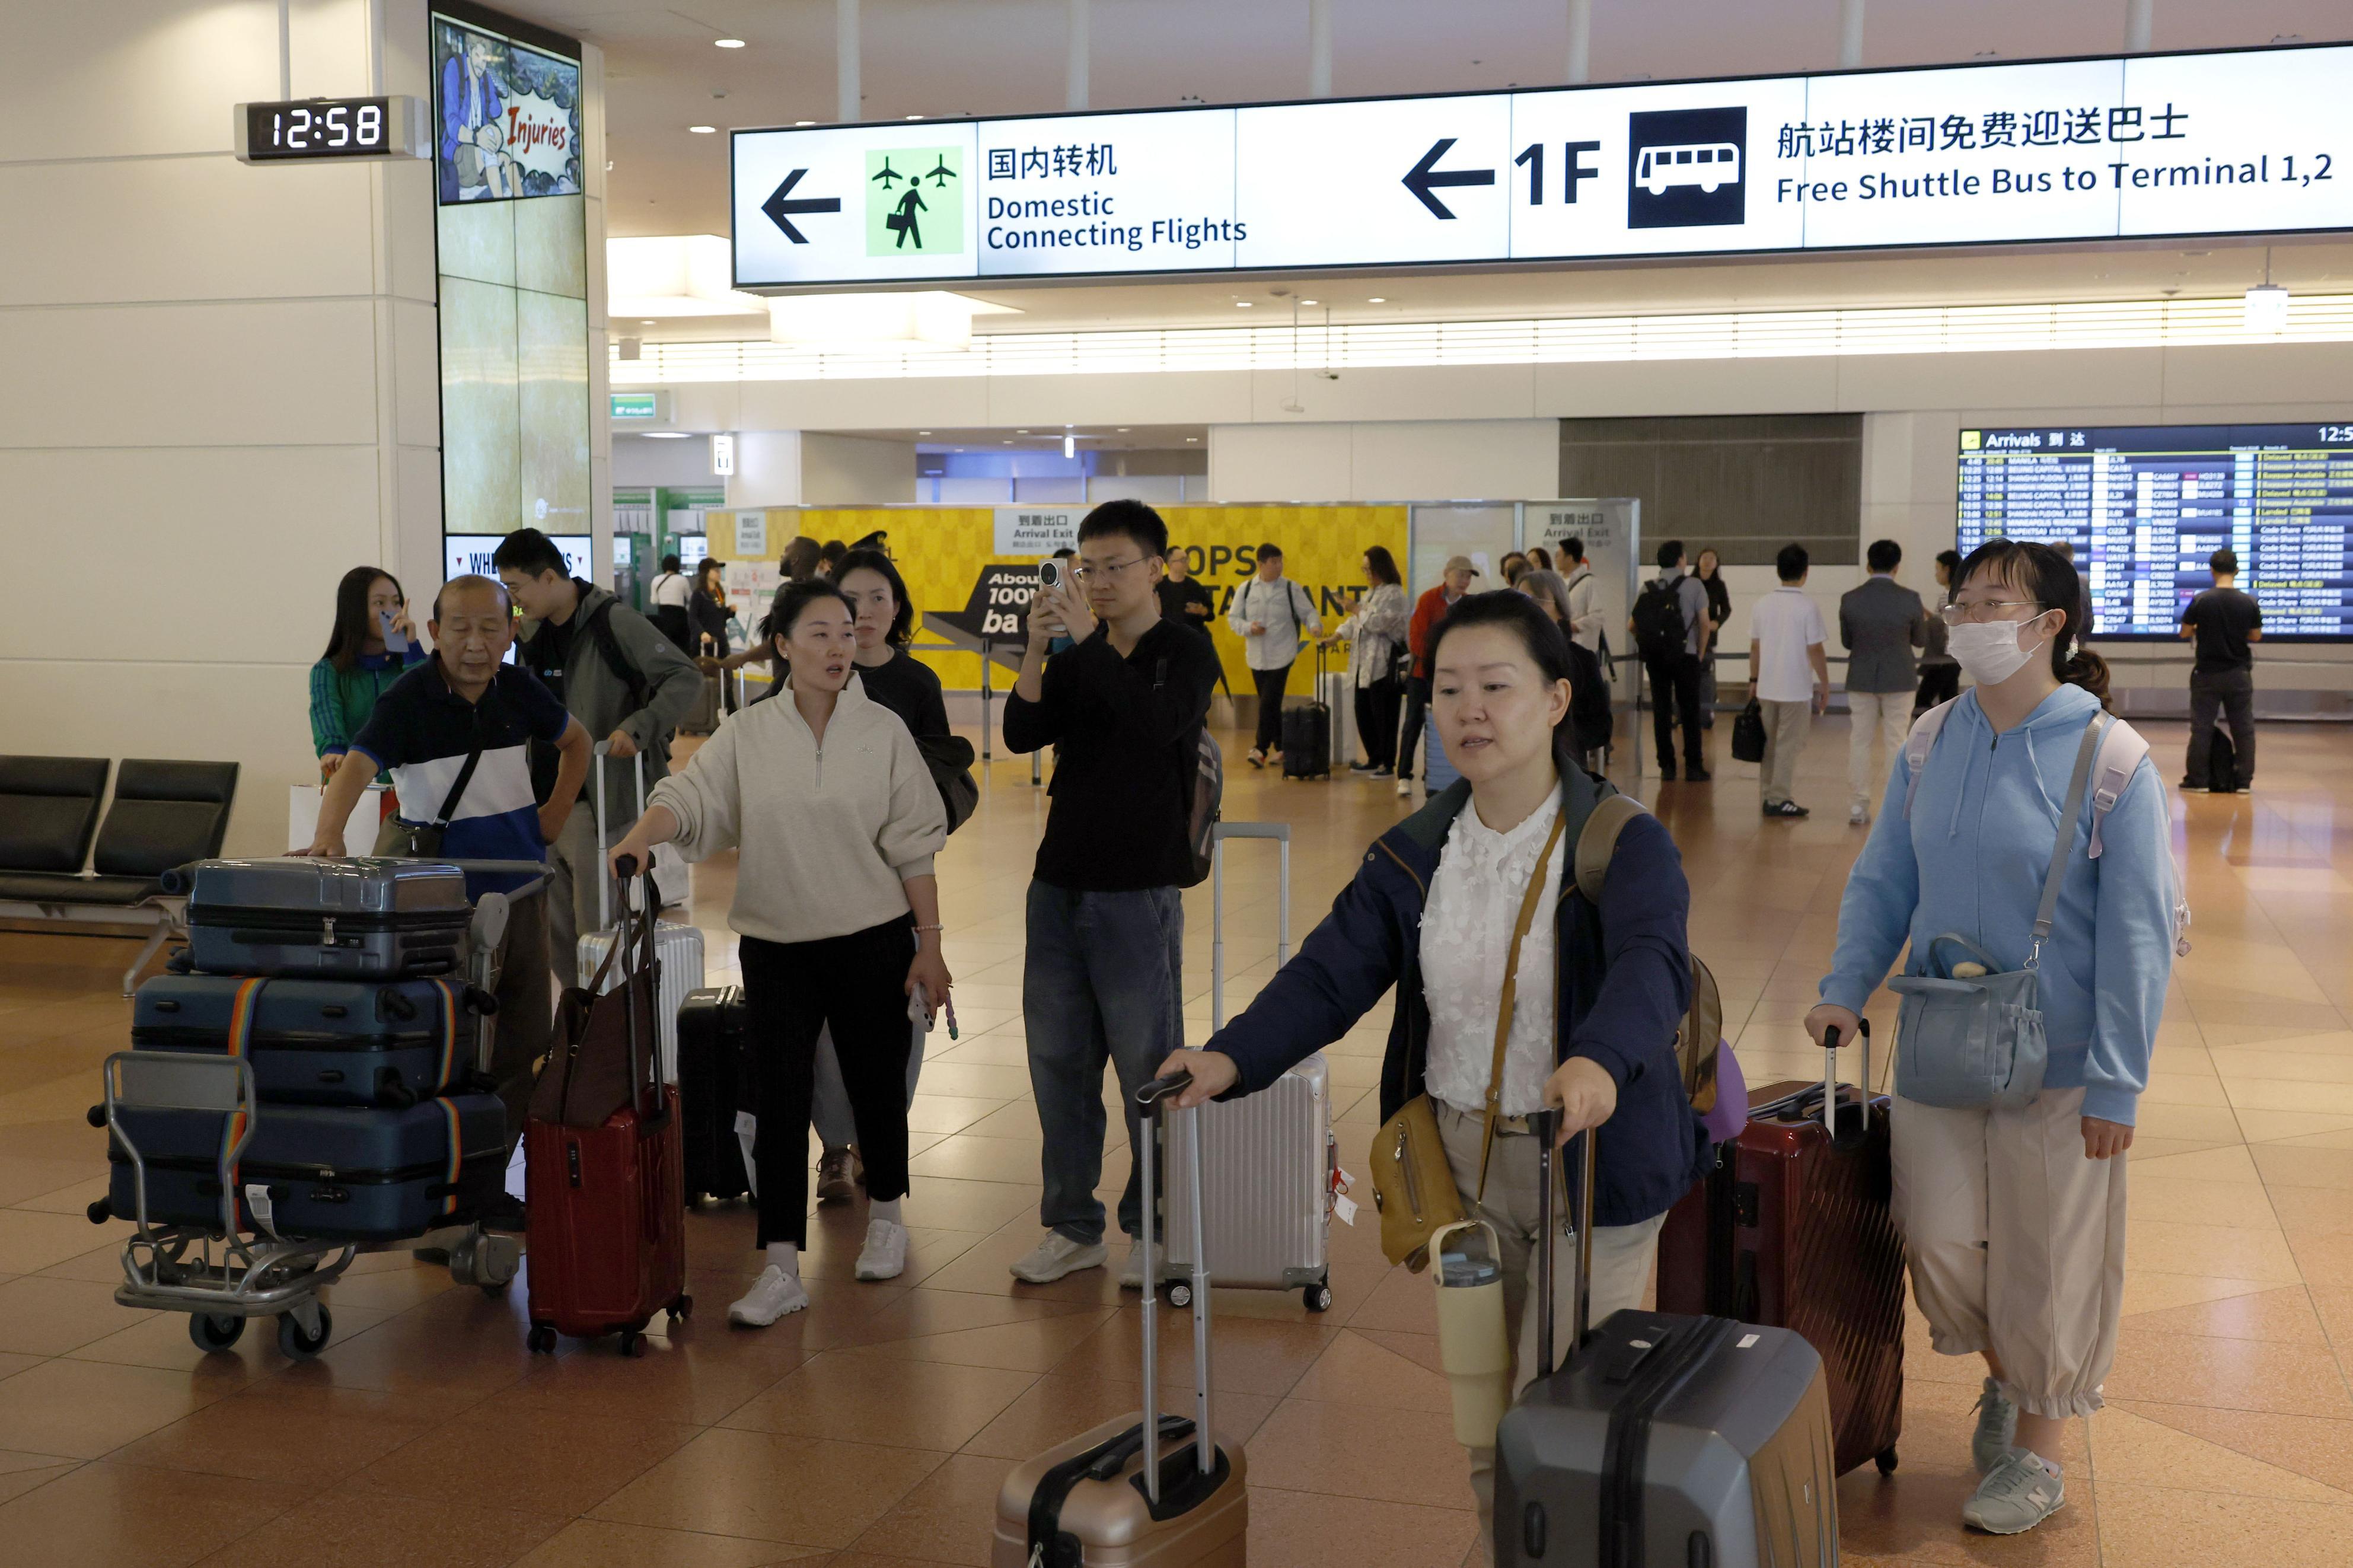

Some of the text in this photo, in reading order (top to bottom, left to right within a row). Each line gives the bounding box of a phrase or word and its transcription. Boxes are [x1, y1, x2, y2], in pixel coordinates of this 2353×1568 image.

[273, 105, 381, 148] 12:58
[506, 106, 566, 154] Injuries
[1778, 102, 2189, 160] 航站楼间免费迎送巴士
[989, 144, 1117, 180] 国内转机
[1515, 141, 1600, 205] 1F
[1778, 152, 2333, 203] Free Shuttle Bus to Terminal 1,2
[989, 191, 1114, 219] Domestic
[987, 217, 1247, 251] Connecting Flights
[1985, 432, 2041, 447] Arrivals
[2318, 427, 2353, 441] 12:5
[1014, 528, 1073, 538] Arrival Exit
[1019, 515, 1067, 526] 到着出口
[1544, 527, 1609, 537] Arrival Exit
[1185, 545, 1257, 576] OPS
[988, 573, 1039, 585] Abou
